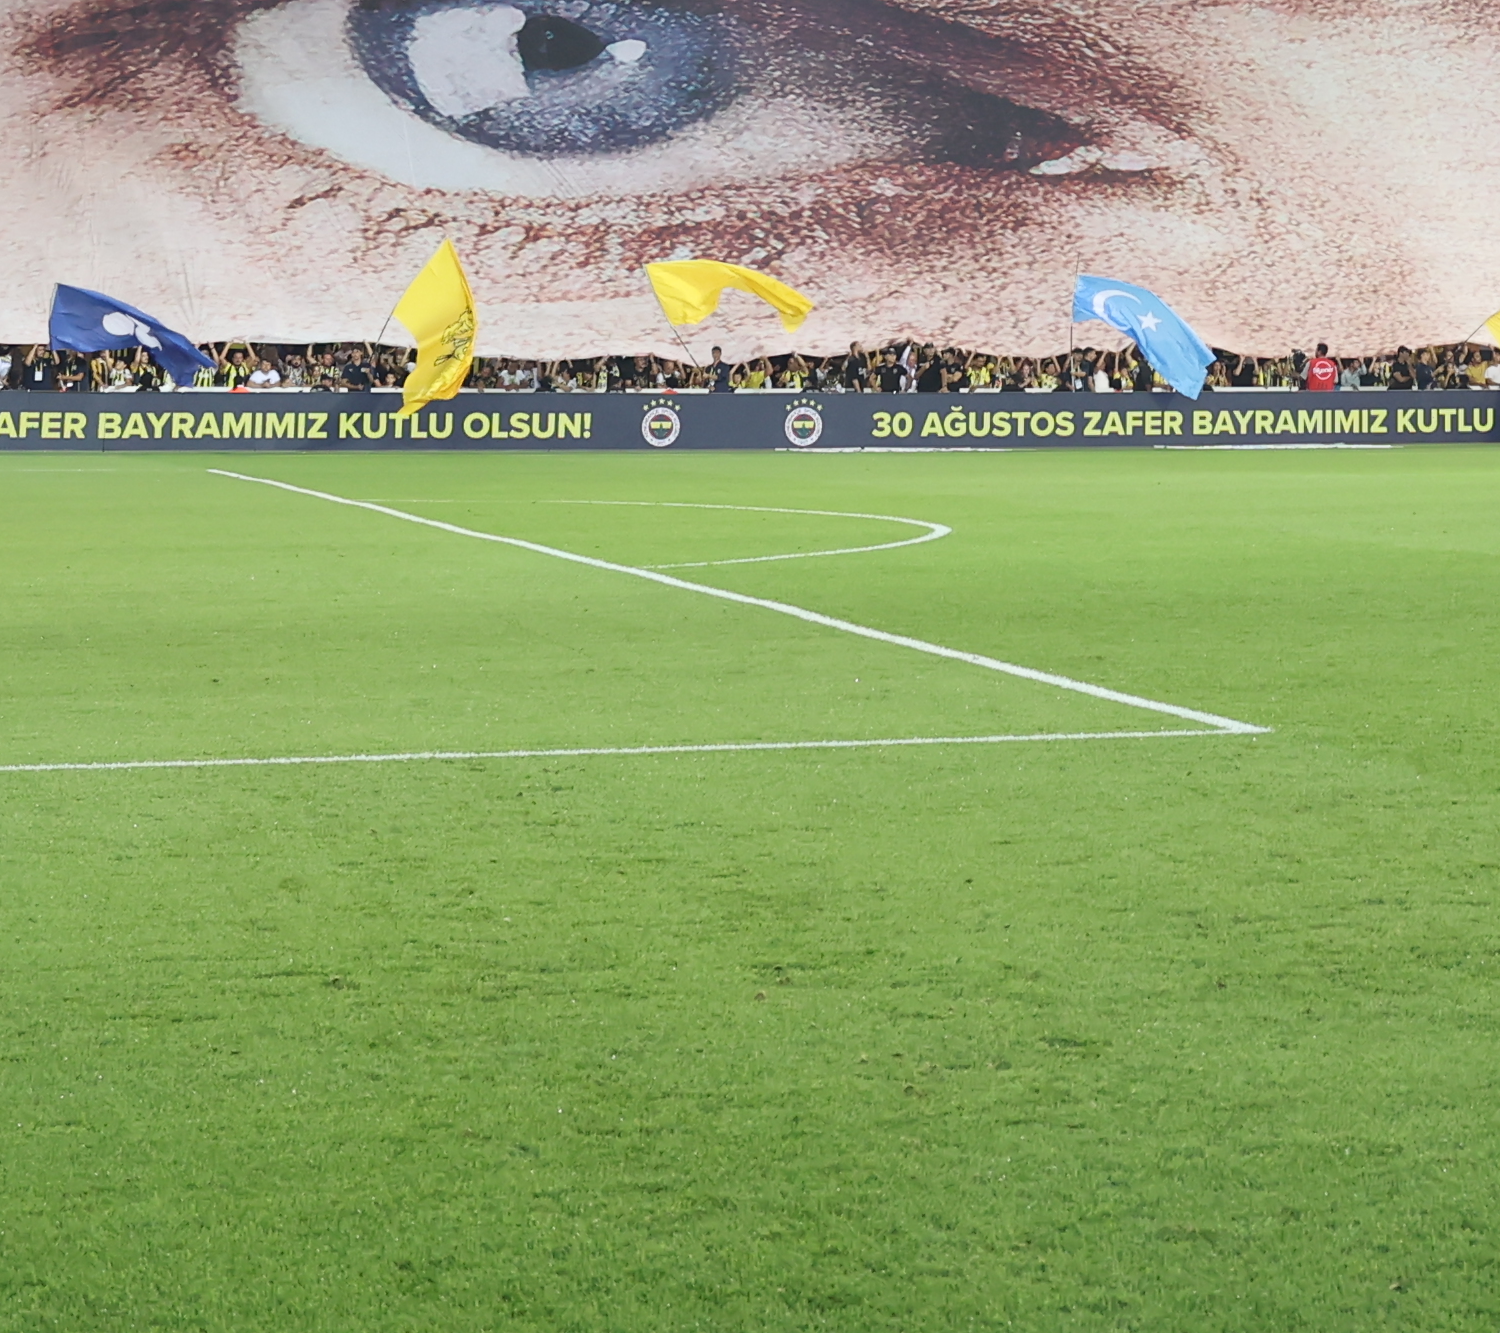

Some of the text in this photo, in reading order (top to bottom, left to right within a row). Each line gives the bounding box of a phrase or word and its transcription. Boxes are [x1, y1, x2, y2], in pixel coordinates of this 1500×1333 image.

[97, 411, 328, 439] BAYRAMIMIZ
[338, 411, 454, 439] KUTLU
[462, 411, 592, 439] OLSUN!
[871, 411, 913, 438] 30
[920, 405, 1076, 438] AĞUSTOS
[1083, 410, 1184, 436] ZAFER
[1192, 408, 1389, 436] BAYRAMIMIZ
[1397, 407, 1494, 434] KUTLU
